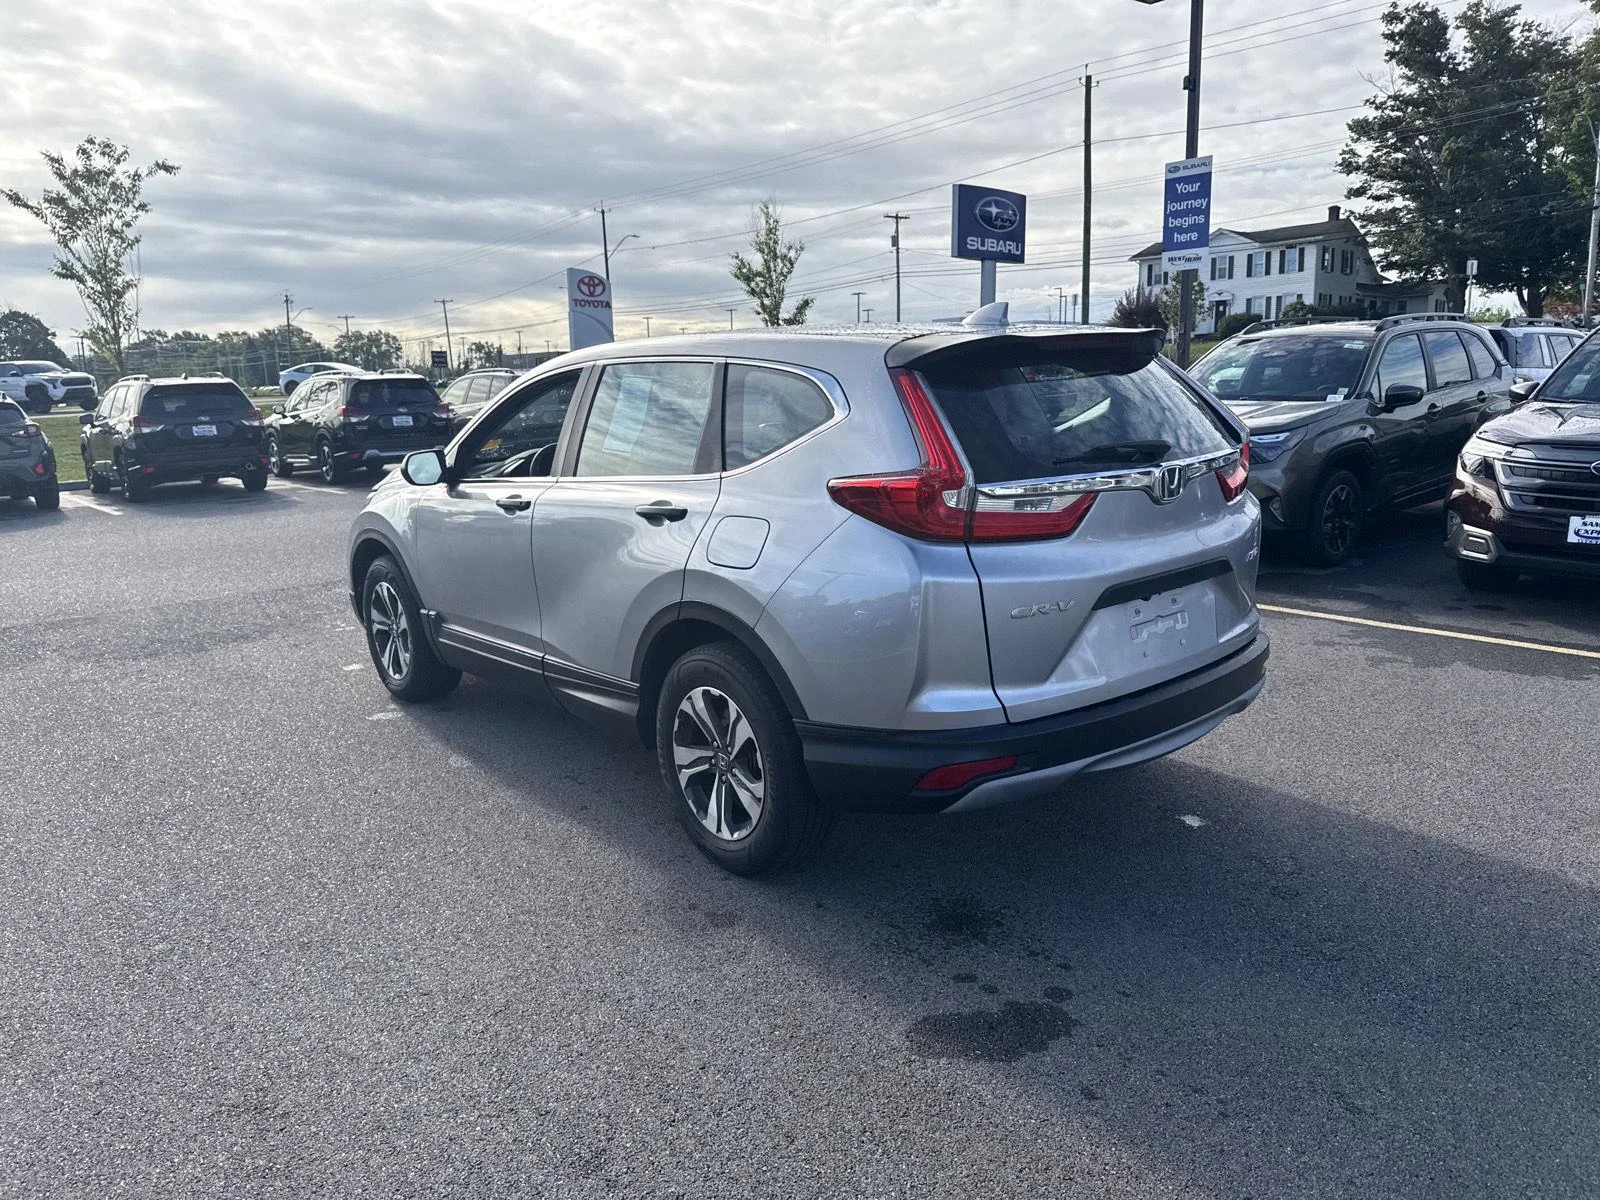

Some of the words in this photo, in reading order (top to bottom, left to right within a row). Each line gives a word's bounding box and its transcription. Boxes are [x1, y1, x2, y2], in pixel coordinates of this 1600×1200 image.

[1182, 161, 1210, 170] SUBARU
[1176, 182, 1200, 193] Your
[1166, 198, 1208, 214] journey
[1169, 214, 1205, 228] begins
[1174, 232, 1198, 243] here
[966, 237, 1021, 254] SUBARU
[573, 299, 611, 308] TOYOTA
[1011, 600, 1075, 619] CR-V
